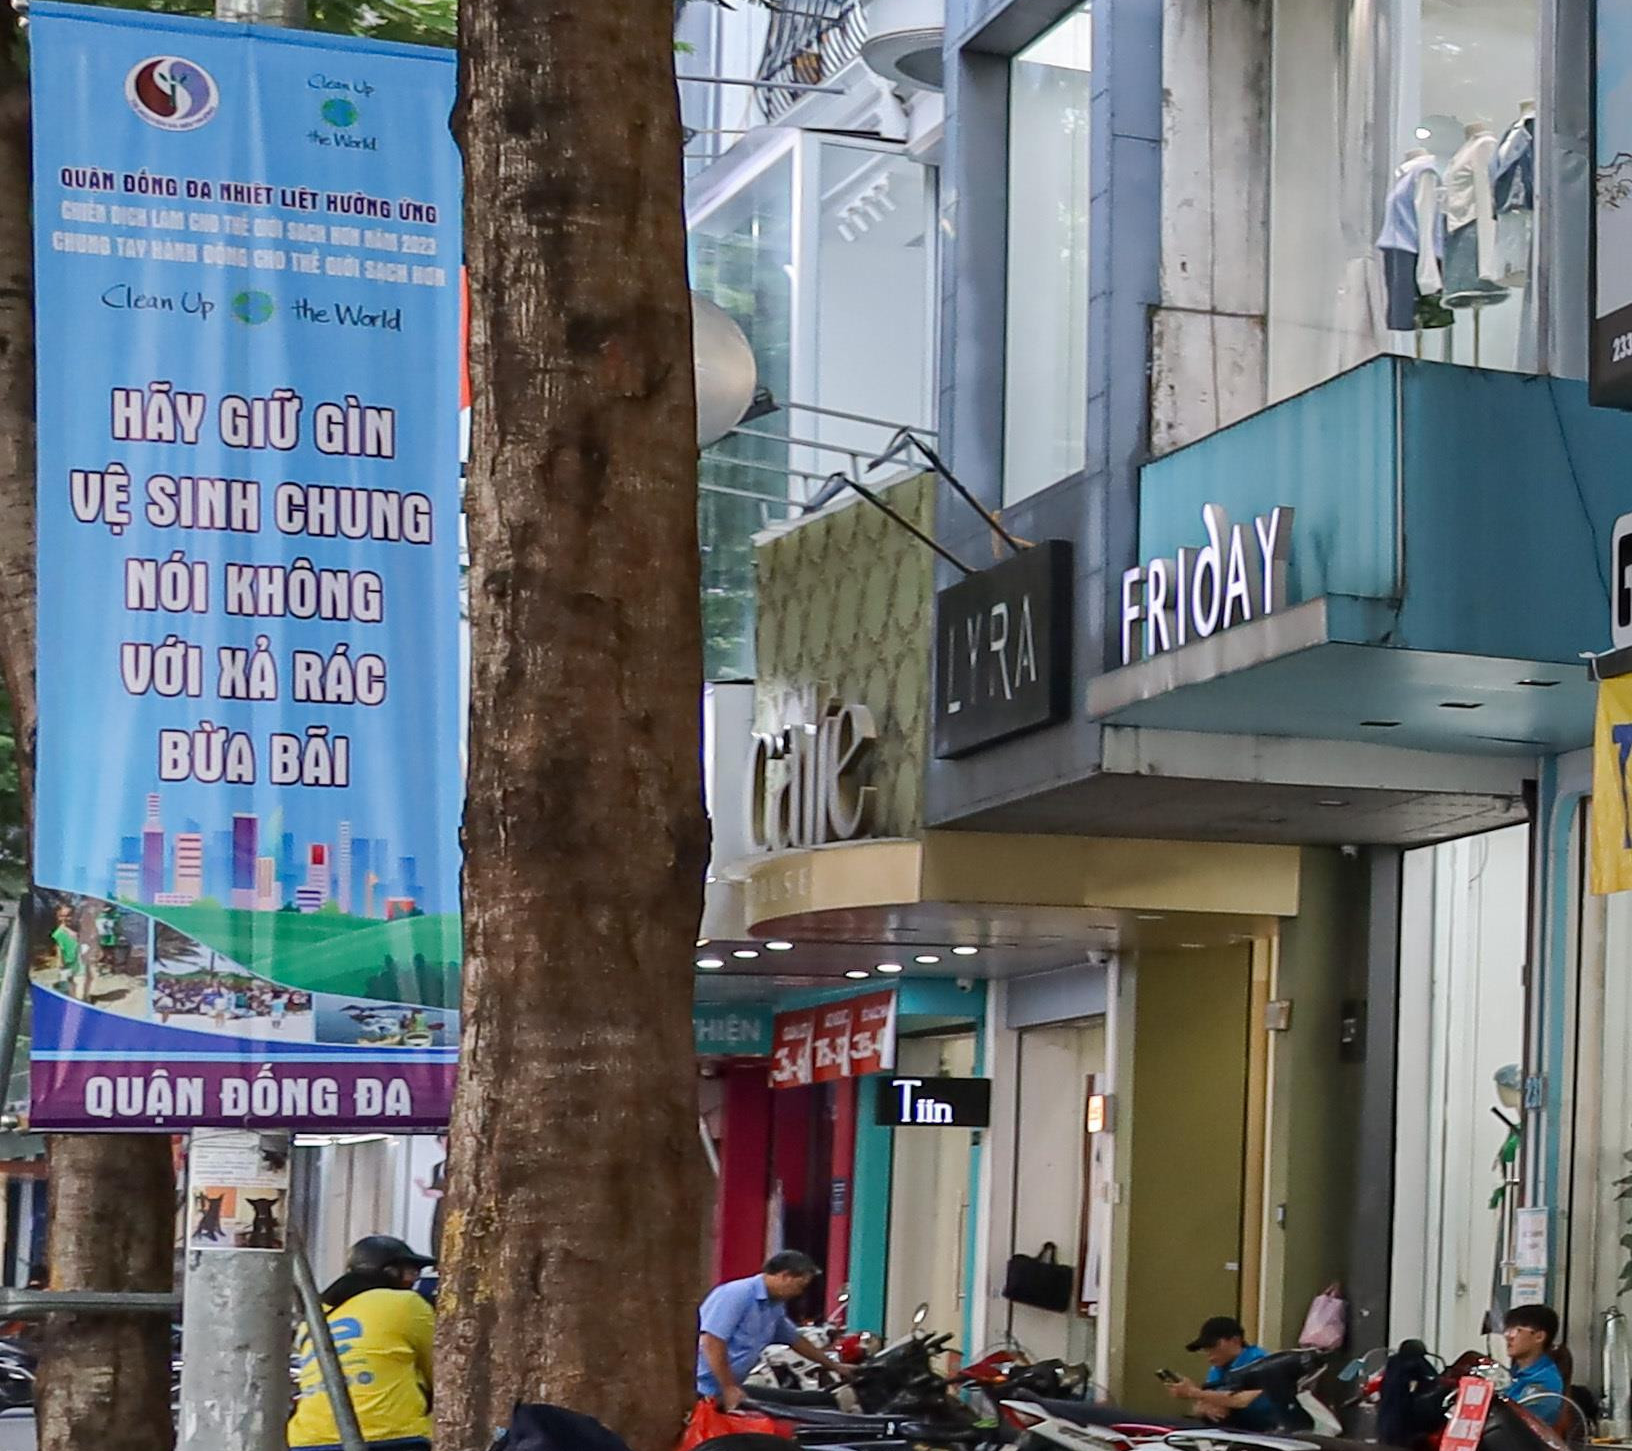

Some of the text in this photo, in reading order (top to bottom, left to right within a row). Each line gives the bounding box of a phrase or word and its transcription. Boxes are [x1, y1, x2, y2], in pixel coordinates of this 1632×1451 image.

[61, 167, 114, 193] QUẬN
[123, 169, 177, 196] ĐỐNG
[186, 180, 212, 200] ĐA
[101, 284, 402, 332] Clean Up the World
[110, 381, 396, 460] HÃY GIỮ GÌN
[70, 462, 433, 545] VỆ SINH CHUNG
[125, 551, 383, 622] NÓI KHÔNG
[120, 633, 387, 705] VỚI XẢ RÁC
[947, 593, 1037, 715] LYRA
[159, 720, 350, 787] BỪA BÃI
[85, 1063, 411, 1126] QUẬN ĐỐNG ĐA
[892, 1080, 953, 1123] Tiin
